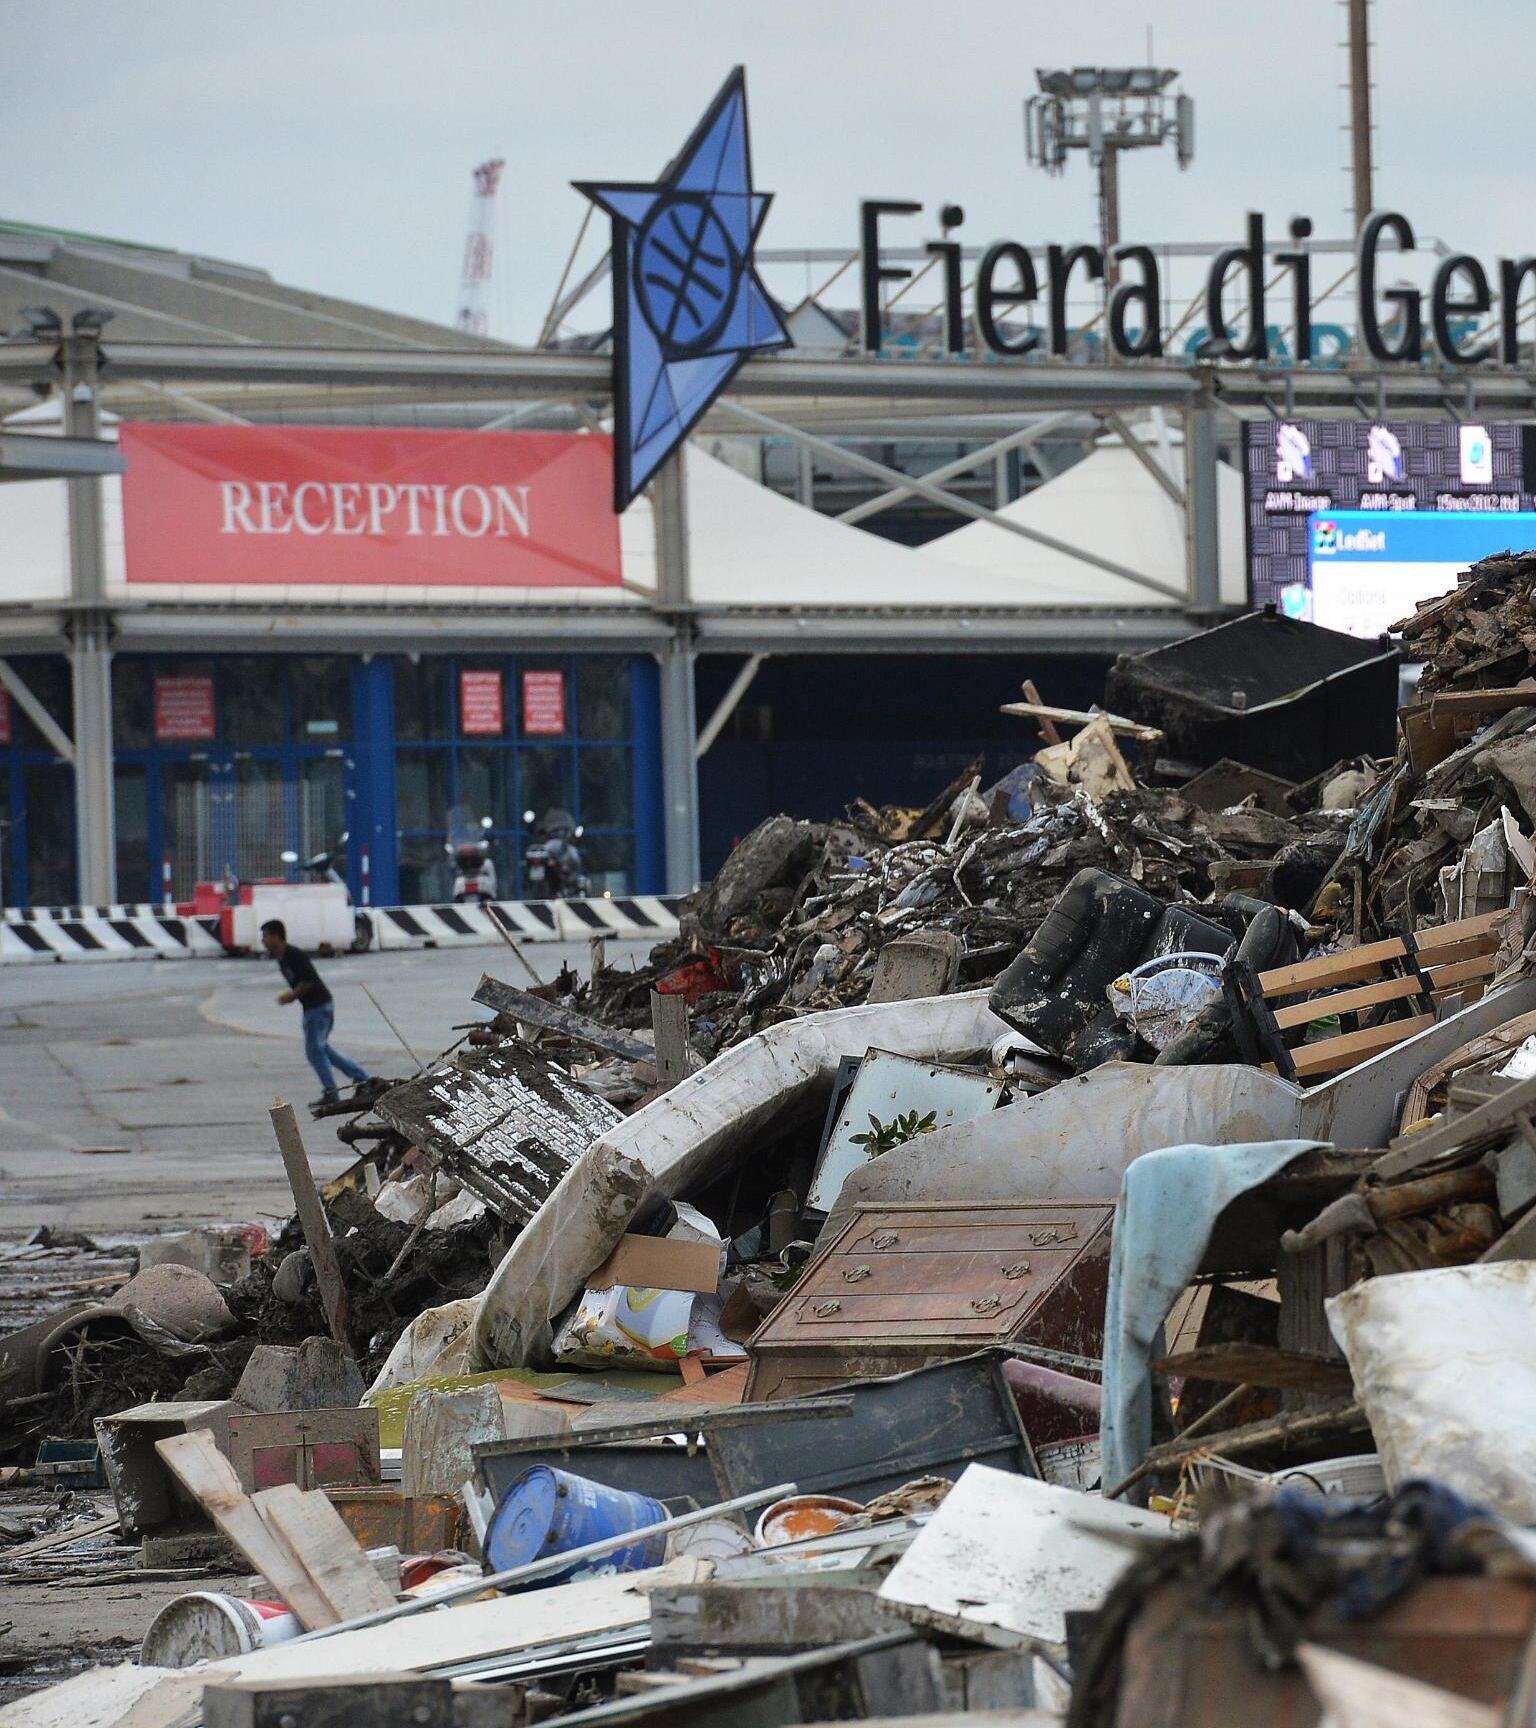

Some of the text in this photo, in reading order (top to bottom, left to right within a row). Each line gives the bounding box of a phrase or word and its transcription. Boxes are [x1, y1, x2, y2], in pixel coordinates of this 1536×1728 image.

[862, 200, 1163, 357] Fiera
[1208, 211, 1312, 361] di
[220, 480, 530, 538] RECEPTION
